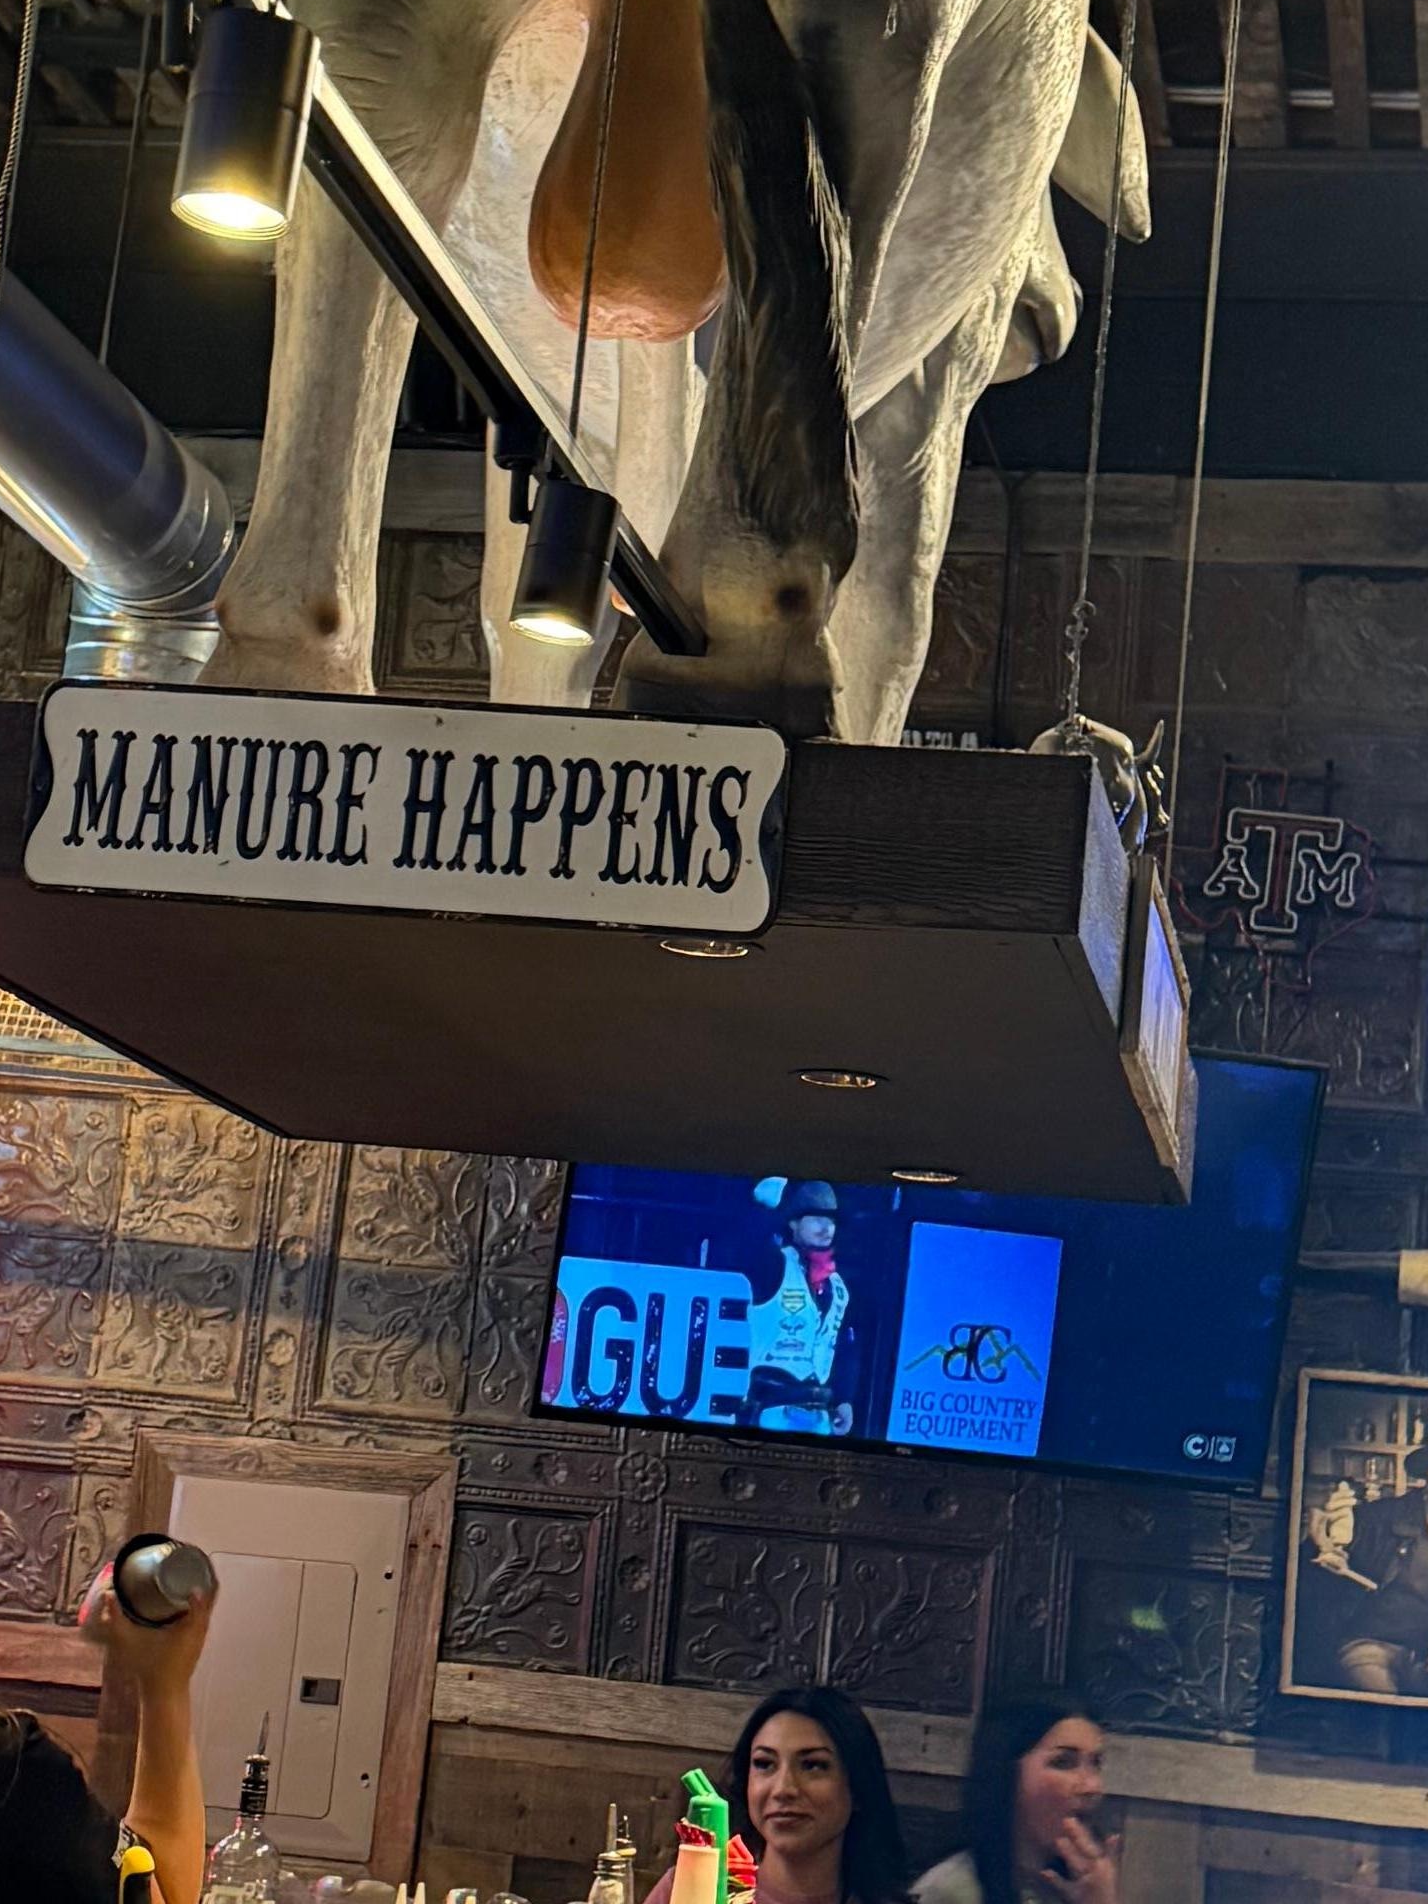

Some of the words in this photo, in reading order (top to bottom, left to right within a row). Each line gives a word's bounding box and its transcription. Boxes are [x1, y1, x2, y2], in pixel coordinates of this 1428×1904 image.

[61, 728, 382, 866] MANURE
[392, 747, 752, 895] HAPPENS
[900, 1389, 936, 1412] BIG
[939, 1391, 1038, 1421] COUNTRY
[904, 1413, 1028, 1444] EQUIPMENT
